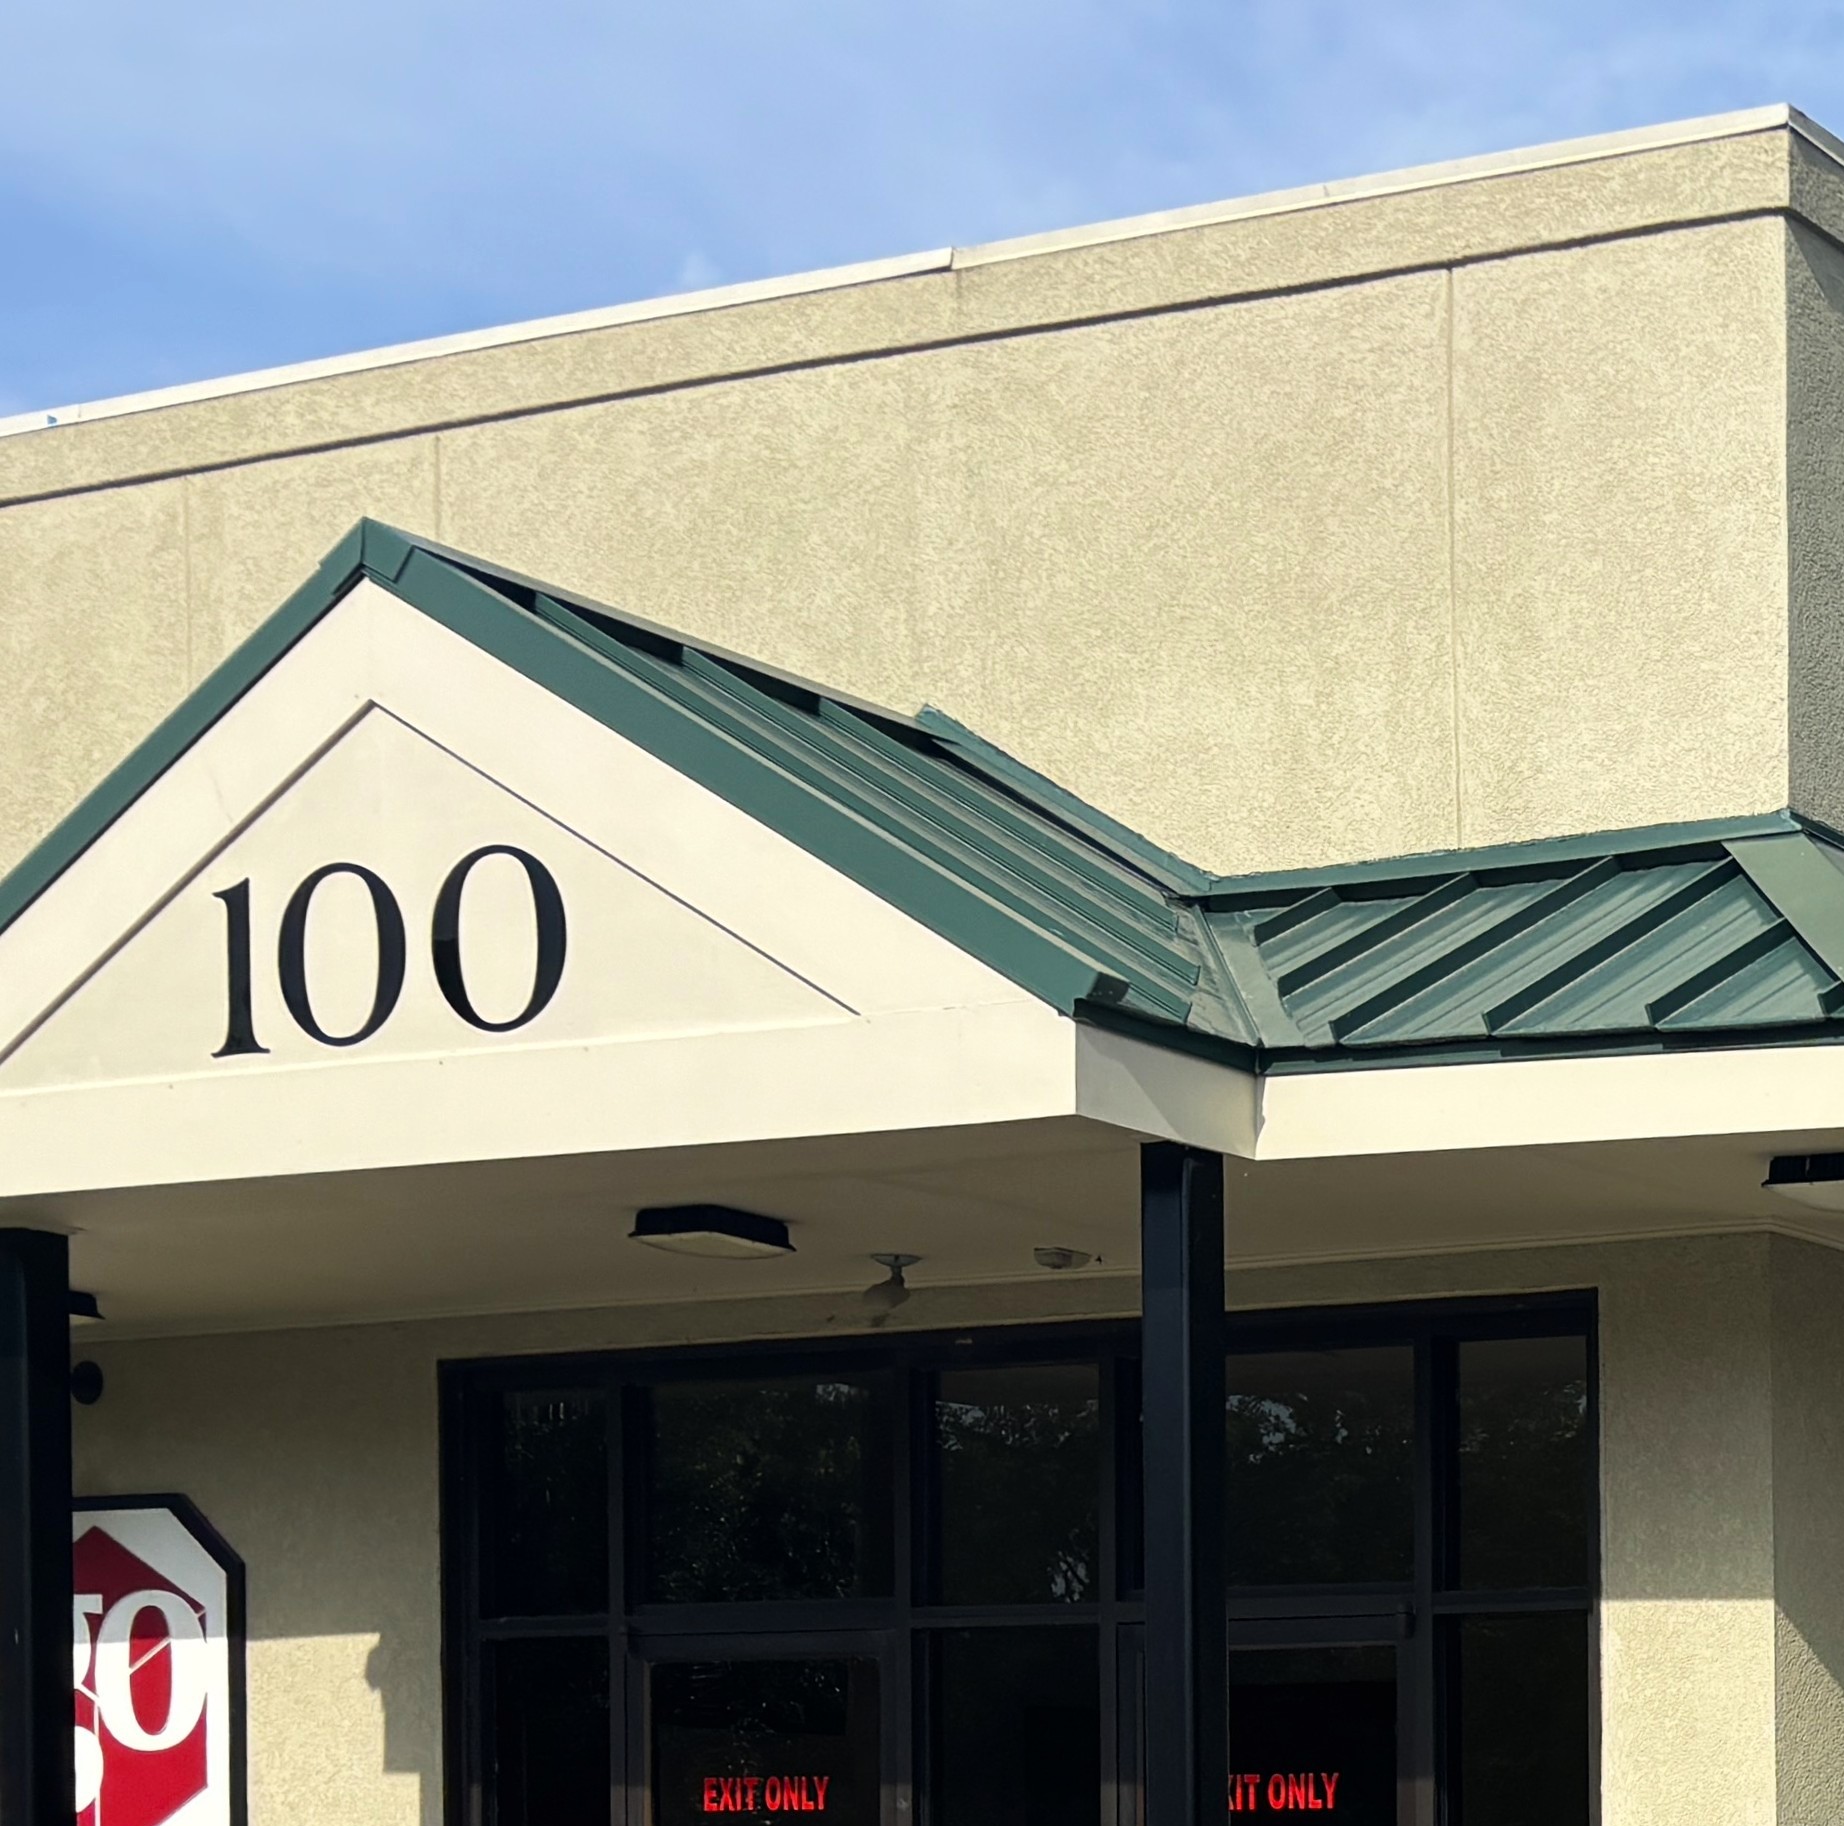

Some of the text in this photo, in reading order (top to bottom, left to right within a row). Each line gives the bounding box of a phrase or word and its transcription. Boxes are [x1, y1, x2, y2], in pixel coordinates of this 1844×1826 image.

[212, 844, 568, 1058] 100
[73, 1588, 208, 1752] O
[703, 1776, 830, 1811] EXIT ONLY
[1267, 1773, 1340, 1810] ONLY
